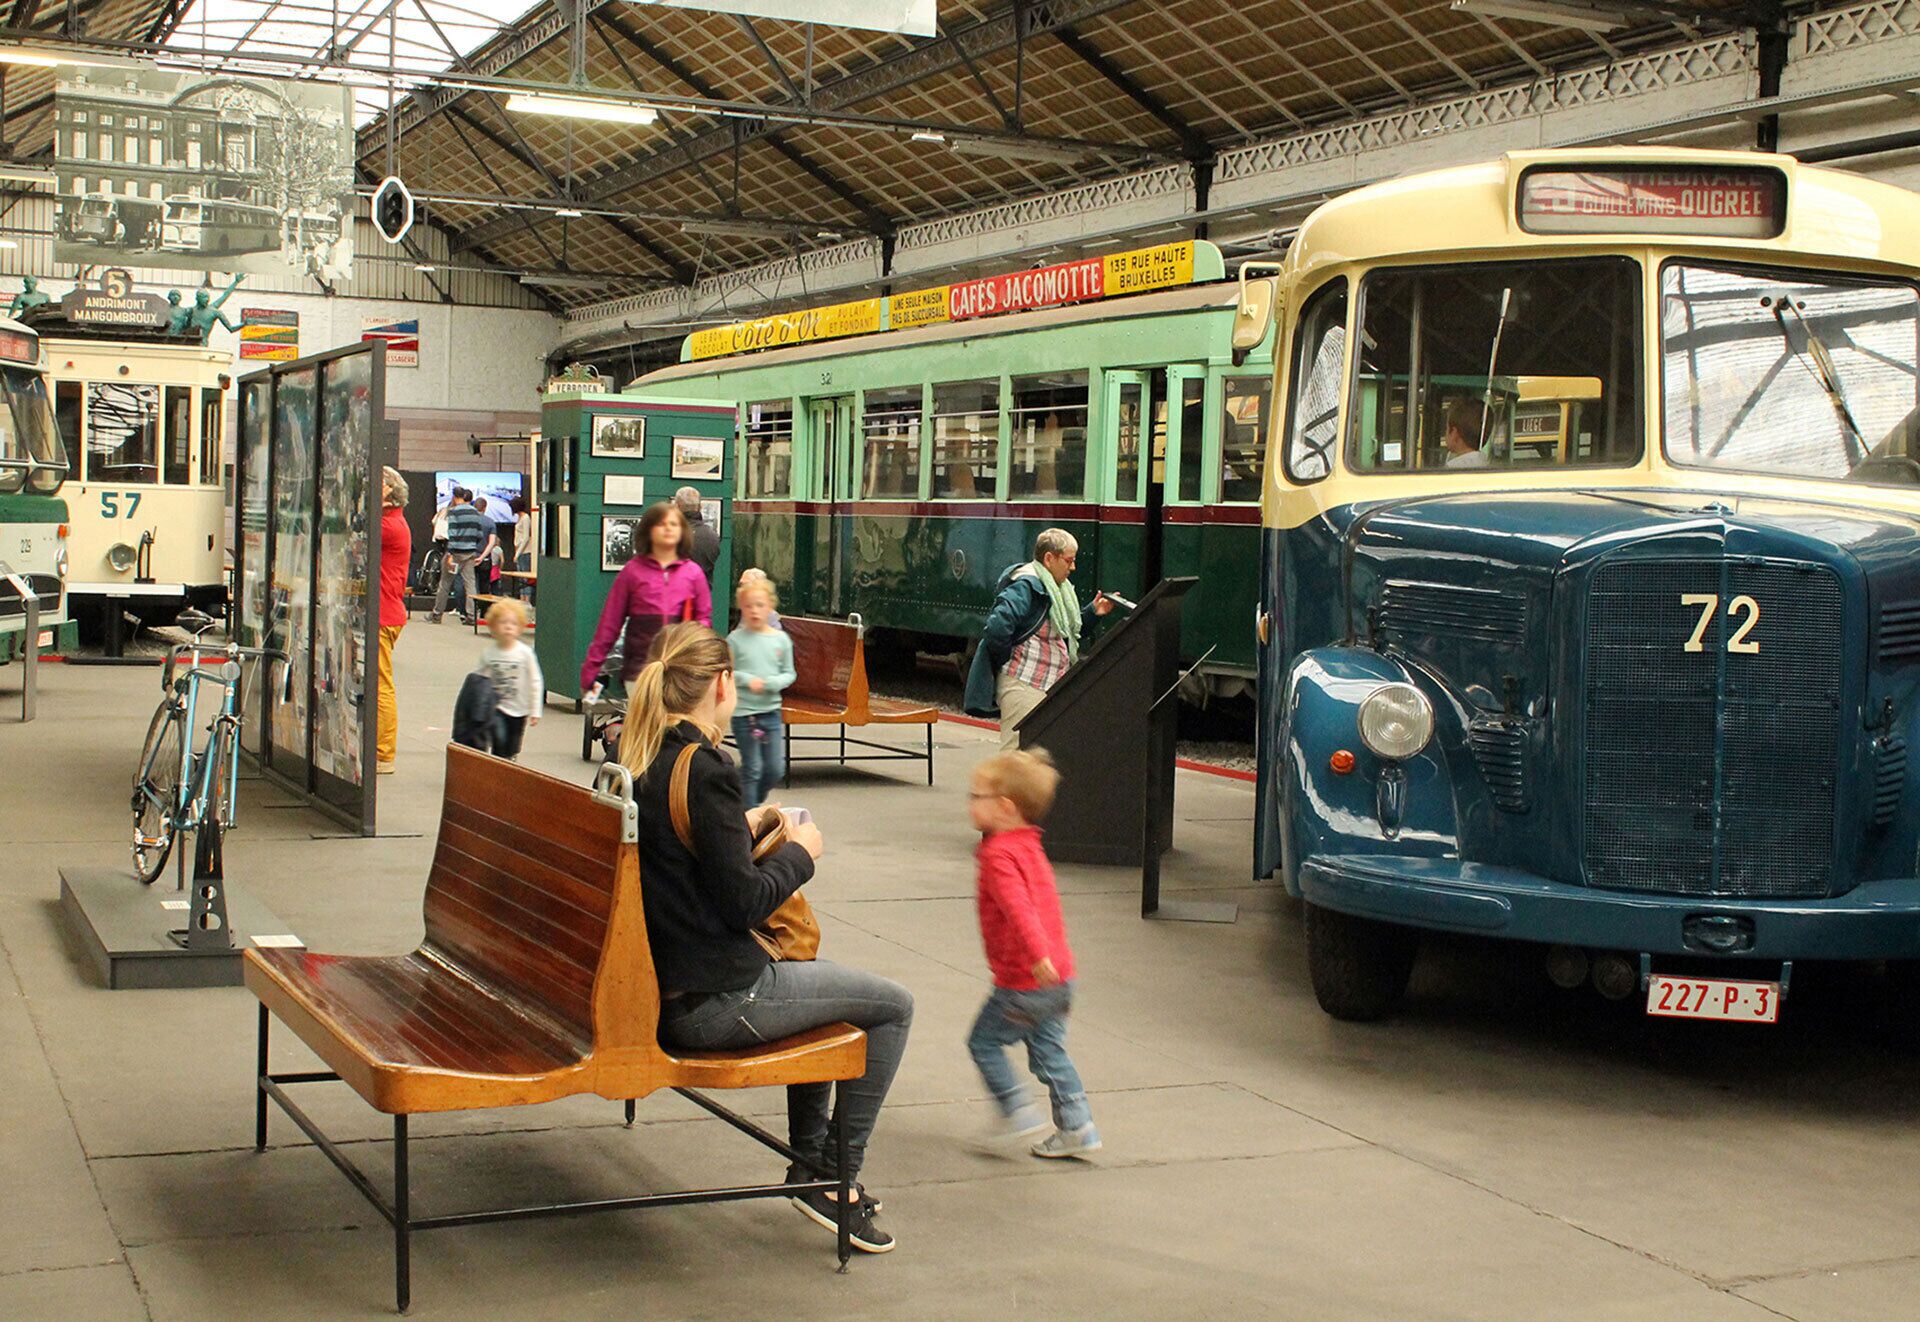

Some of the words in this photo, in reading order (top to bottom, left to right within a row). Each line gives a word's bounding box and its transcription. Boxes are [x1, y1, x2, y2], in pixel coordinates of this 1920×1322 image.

[1581, 196, 1677, 215] GUILLEMINS
[1680, 188, 1763, 216] OUGREE
[1110, 258, 1127, 274] 139
[1131, 254, 1150, 270] RUE
[1153, 246, 1187, 265] HAUTE
[106, 271, 127, 299] 5
[1120, 266, 1176, 288] BRUXELLES
[893, 297, 905, 310] UNE
[906, 294, 922, 309] SEULE
[923, 291, 943, 306] MAISON
[950, 280, 996, 317] CAFÉS
[1002, 262, 1101, 309] JACQMOTTE
[85, 297, 147, 310] ANDRIMONT
[838, 307, 848, 319] AU
[849, 304, 867, 317] LAIT
[892, 311, 902, 324] PAS
[903, 310, 911, 322] DE
[911, 305, 945, 322] SUCCURSALE
[74, 310, 157, 324] MANGOMBROUX
[829, 322, 838, 334] ET
[839, 316, 875, 332] FONDANT
[101, 491, 142, 519] 57
[1681, 593, 1761, 654] 72
